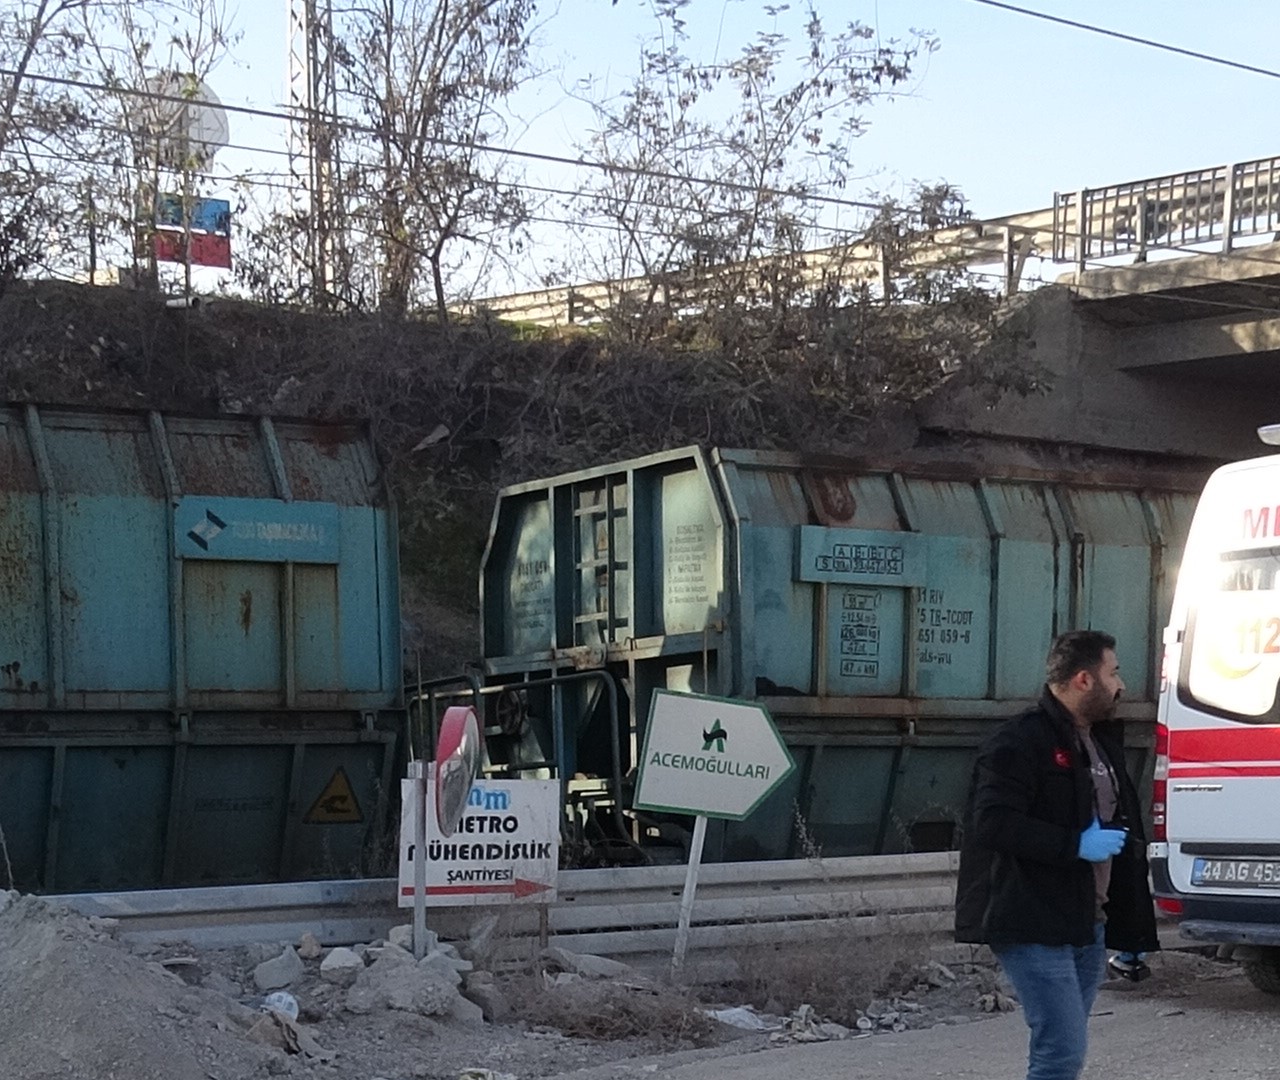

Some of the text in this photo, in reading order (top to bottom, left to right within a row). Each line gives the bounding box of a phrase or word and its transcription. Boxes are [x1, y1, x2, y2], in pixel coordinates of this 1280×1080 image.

[650, 751, 771, 780] ACEMOĞULLARI
[446, 867, 514, 885] ŞANTİYESİ
[1202, 861, 1222, 881] 44
[1224, 861, 1250, 881] AG
